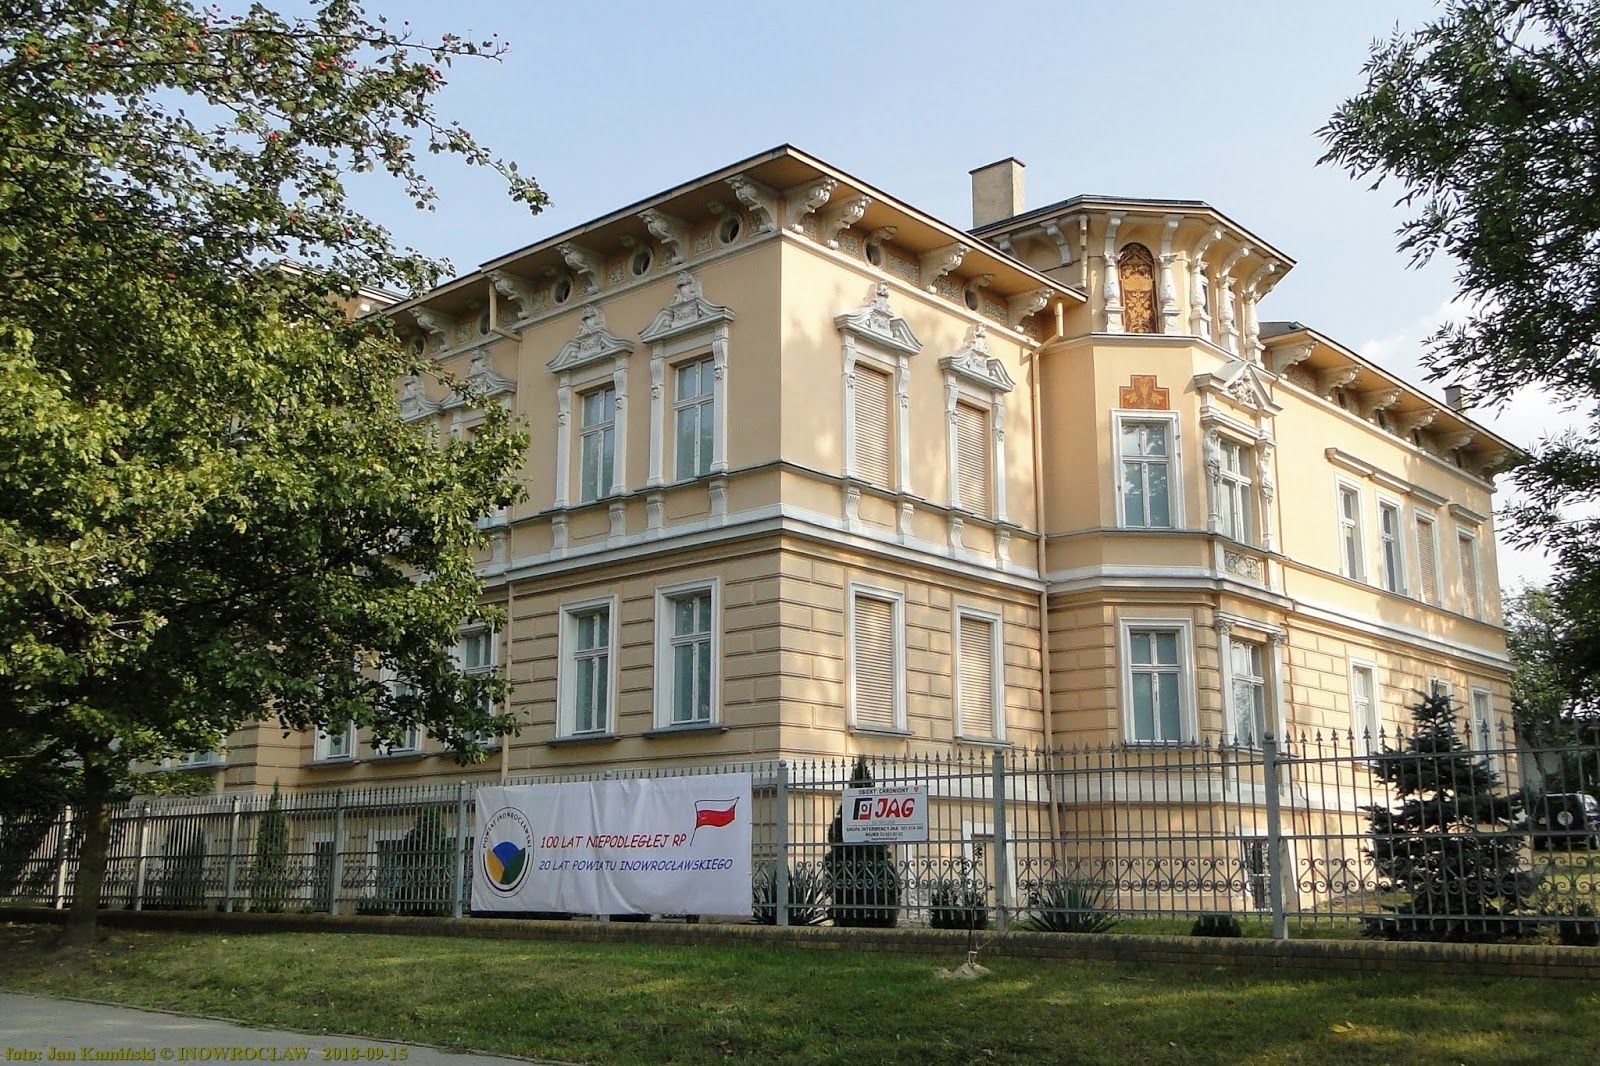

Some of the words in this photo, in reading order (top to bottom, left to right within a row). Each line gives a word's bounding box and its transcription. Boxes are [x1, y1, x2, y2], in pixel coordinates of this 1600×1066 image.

[875, 798, 915, 818] JAG
[482, 819, 498, 849] POWIAT
[540, 836, 559, 848] 100
[561, 836, 583, 848] LAT
[586, 834, 669, 848] NIEPODLEGŁEJ
[672, 833, 687, 847] RP
[538, 860, 551, 871] 20
[552, 860, 571, 871] LAT
[572, 860, 617, 871] POWIATU
[619, 858, 733, 871] INOWROCŁAWSKIEGO
